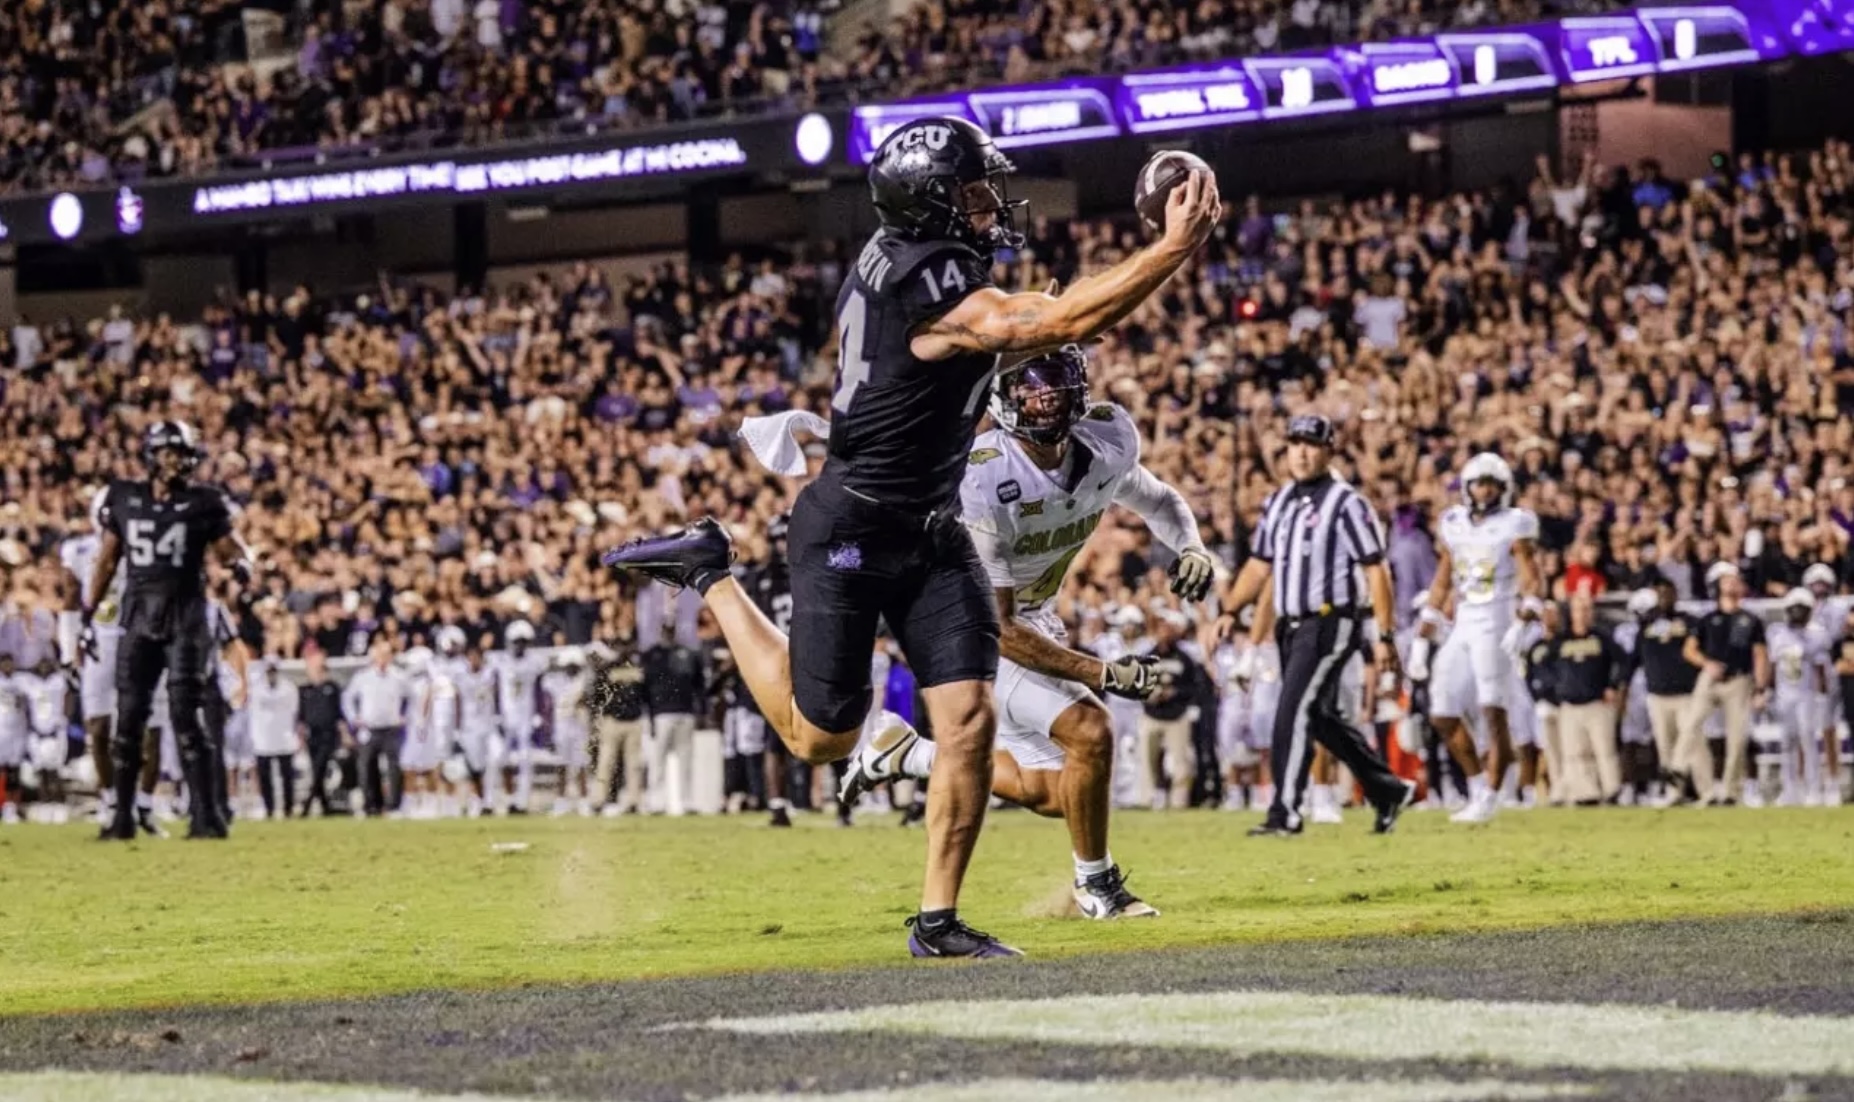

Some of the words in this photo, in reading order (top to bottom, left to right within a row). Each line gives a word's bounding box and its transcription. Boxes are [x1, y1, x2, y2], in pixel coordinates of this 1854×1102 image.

[886, 125, 952, 161] TCU
[920, 259, 966, 302] 14
[127, 518, 186, 567] 54
